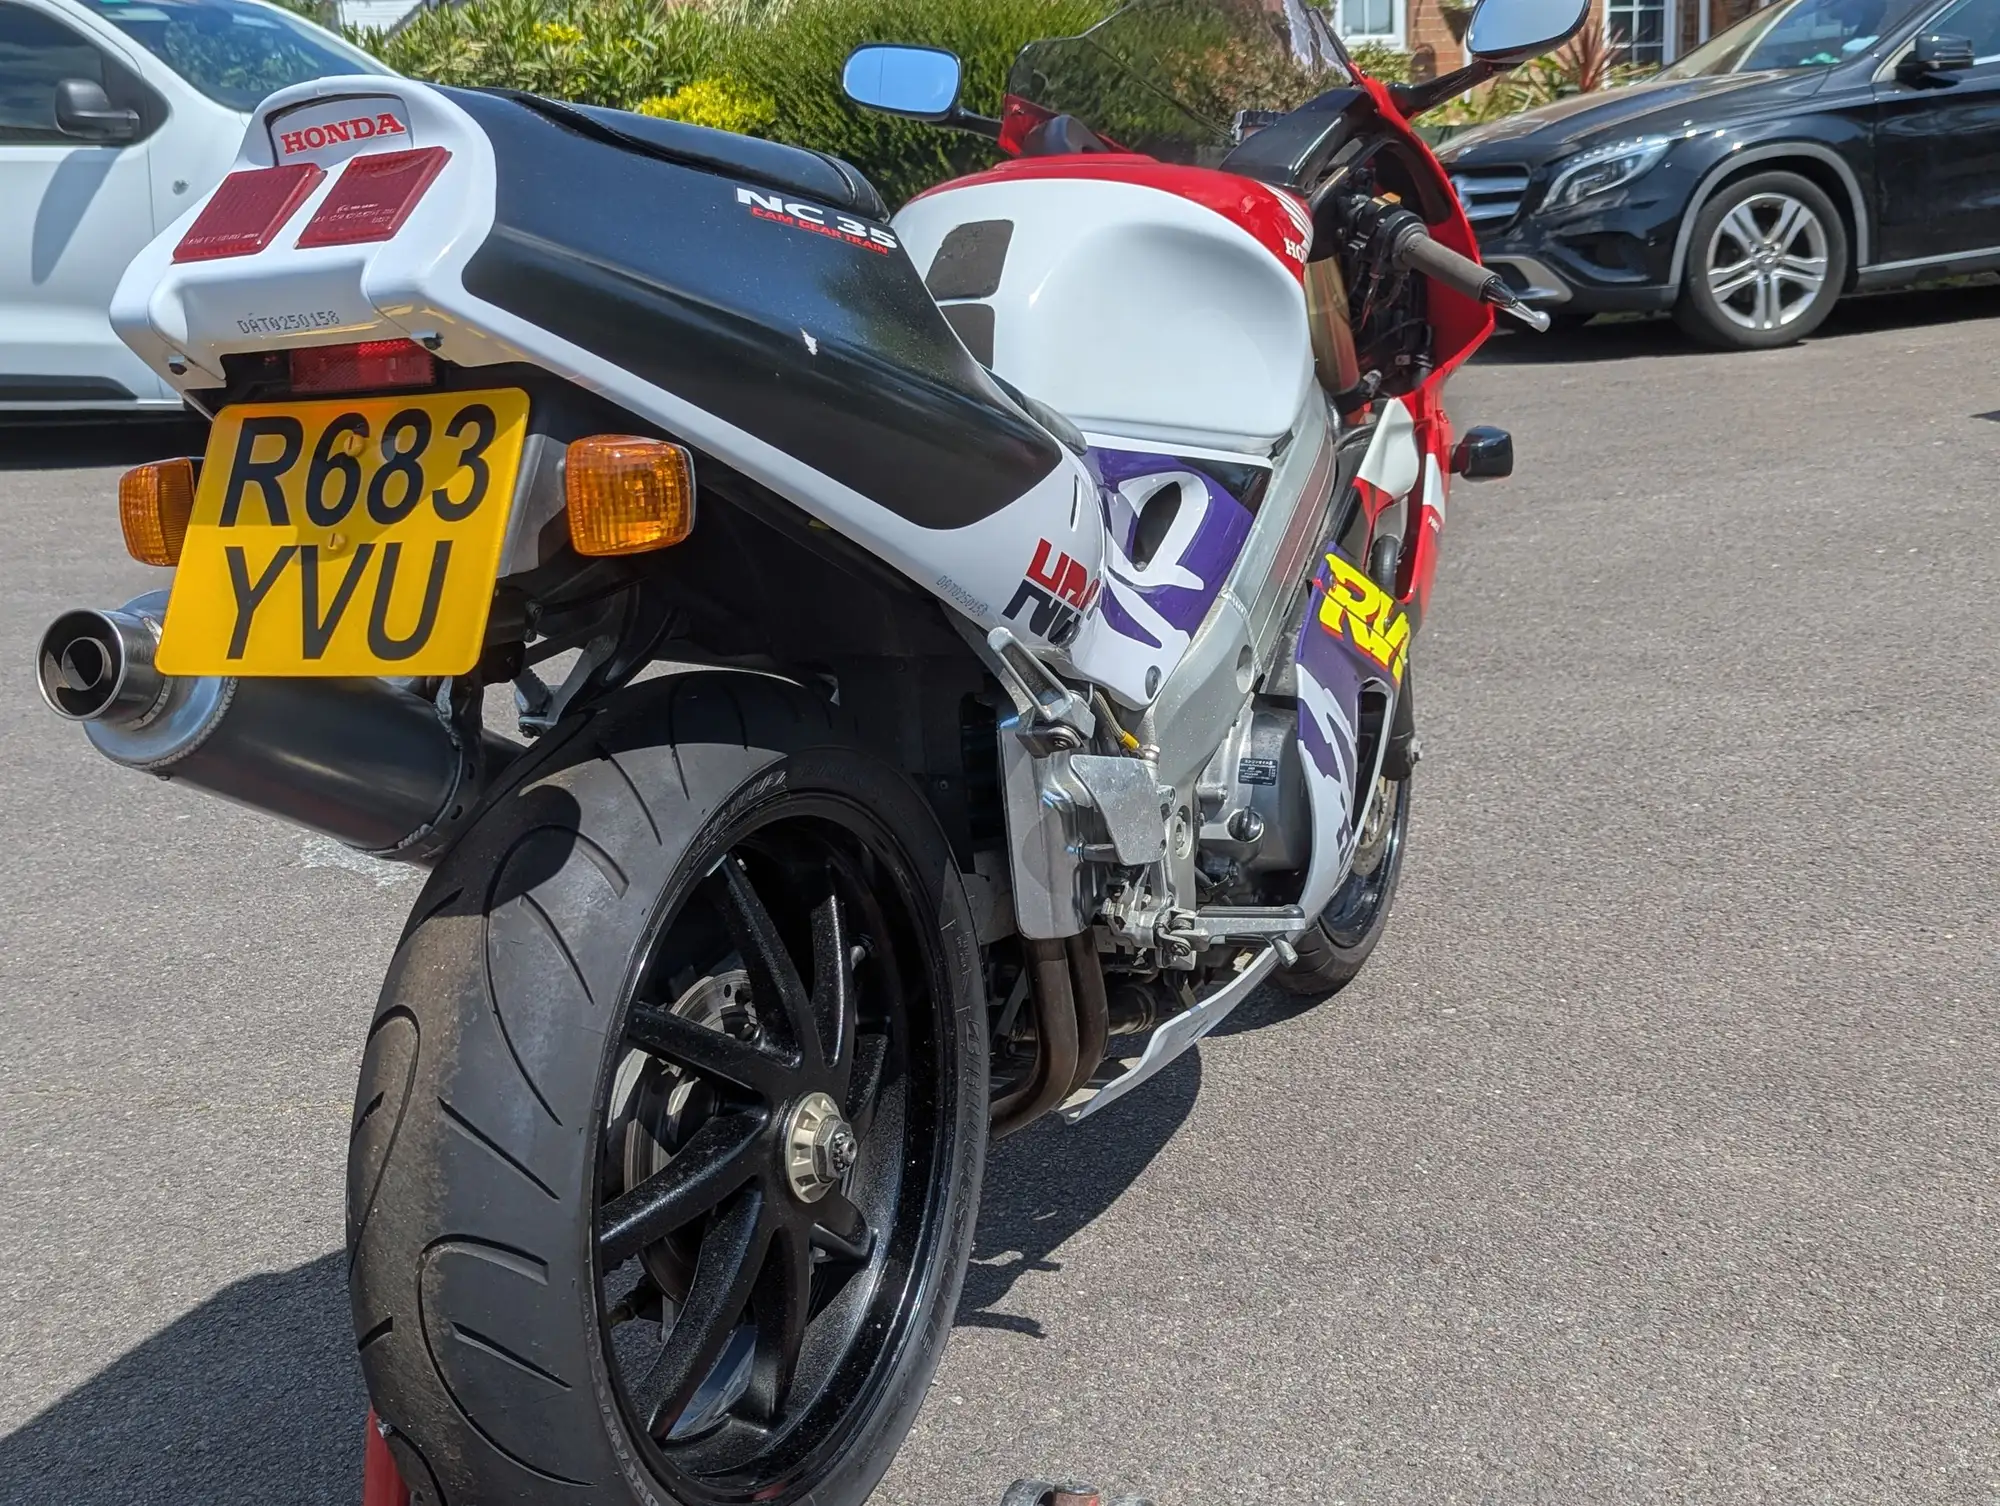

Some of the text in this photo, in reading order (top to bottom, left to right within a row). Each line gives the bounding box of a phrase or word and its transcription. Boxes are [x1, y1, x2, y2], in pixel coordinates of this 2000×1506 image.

[280, 112, 406, 156] HONDA
[736, 187, 898, 249] NC 35
[751, 206, 889, 257] CAM GEAR TRAIN
[1283, 237, 1308, 265] HO
[236, 310, 341, 334] DAT0250158
[218, 403, 498, 528] R683
[225, 540, 453, 662] YVU
